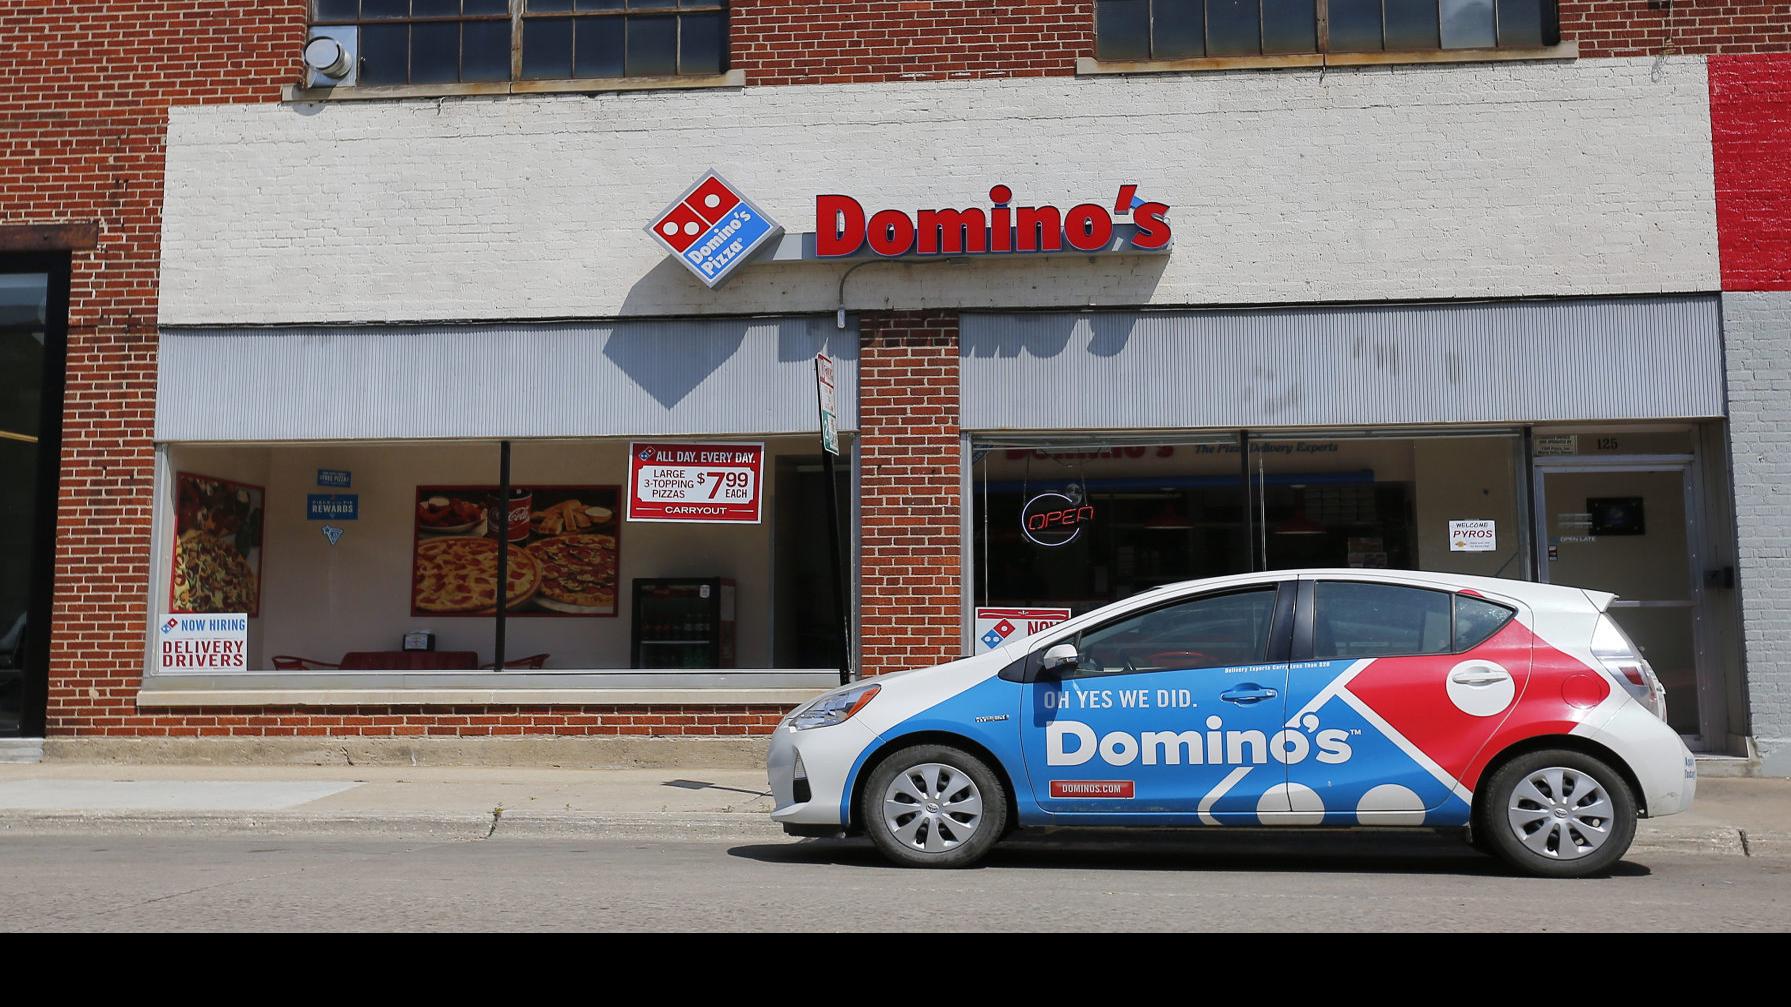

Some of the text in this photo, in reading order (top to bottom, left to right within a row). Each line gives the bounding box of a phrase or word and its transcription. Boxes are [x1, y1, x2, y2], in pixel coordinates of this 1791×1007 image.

[815, 183, 1172, 257] Domino's
[687, 210, 752, 265] Domino's
[1196, 444, 1215, 454] The
[1295, 442, 1338, 454] Experts
[1597, 438, 1618, 449] 125
[656, 451, 756, 464] ALL DAY. EVERY DAY.
[653, 469, 686, 479] LARGE
[643, 479, 694, 489] 3-TOPPING
[652, 489, 685, 499] PIZZAS
[725, 488, 748, 498] EACH
[312, 504, 353, 513] REWARDS
[665, 506, 727, 515] CARRYOUT
[1027, 504, 1096, 532] OPEN
[1453, 530, 1494, 538] PYROS
[1559, 535, 1579, 543] OPEN
[181, 618, 245, 631] NOW HIRING
[162, 640, 244, 654] DELIVERY
[162, 653, 244, 667] DRIVERS
[1044, 689, 1198, 710] OH YES WE DID.
[1061, 783, 1122, 795] DOMINOS.COM
